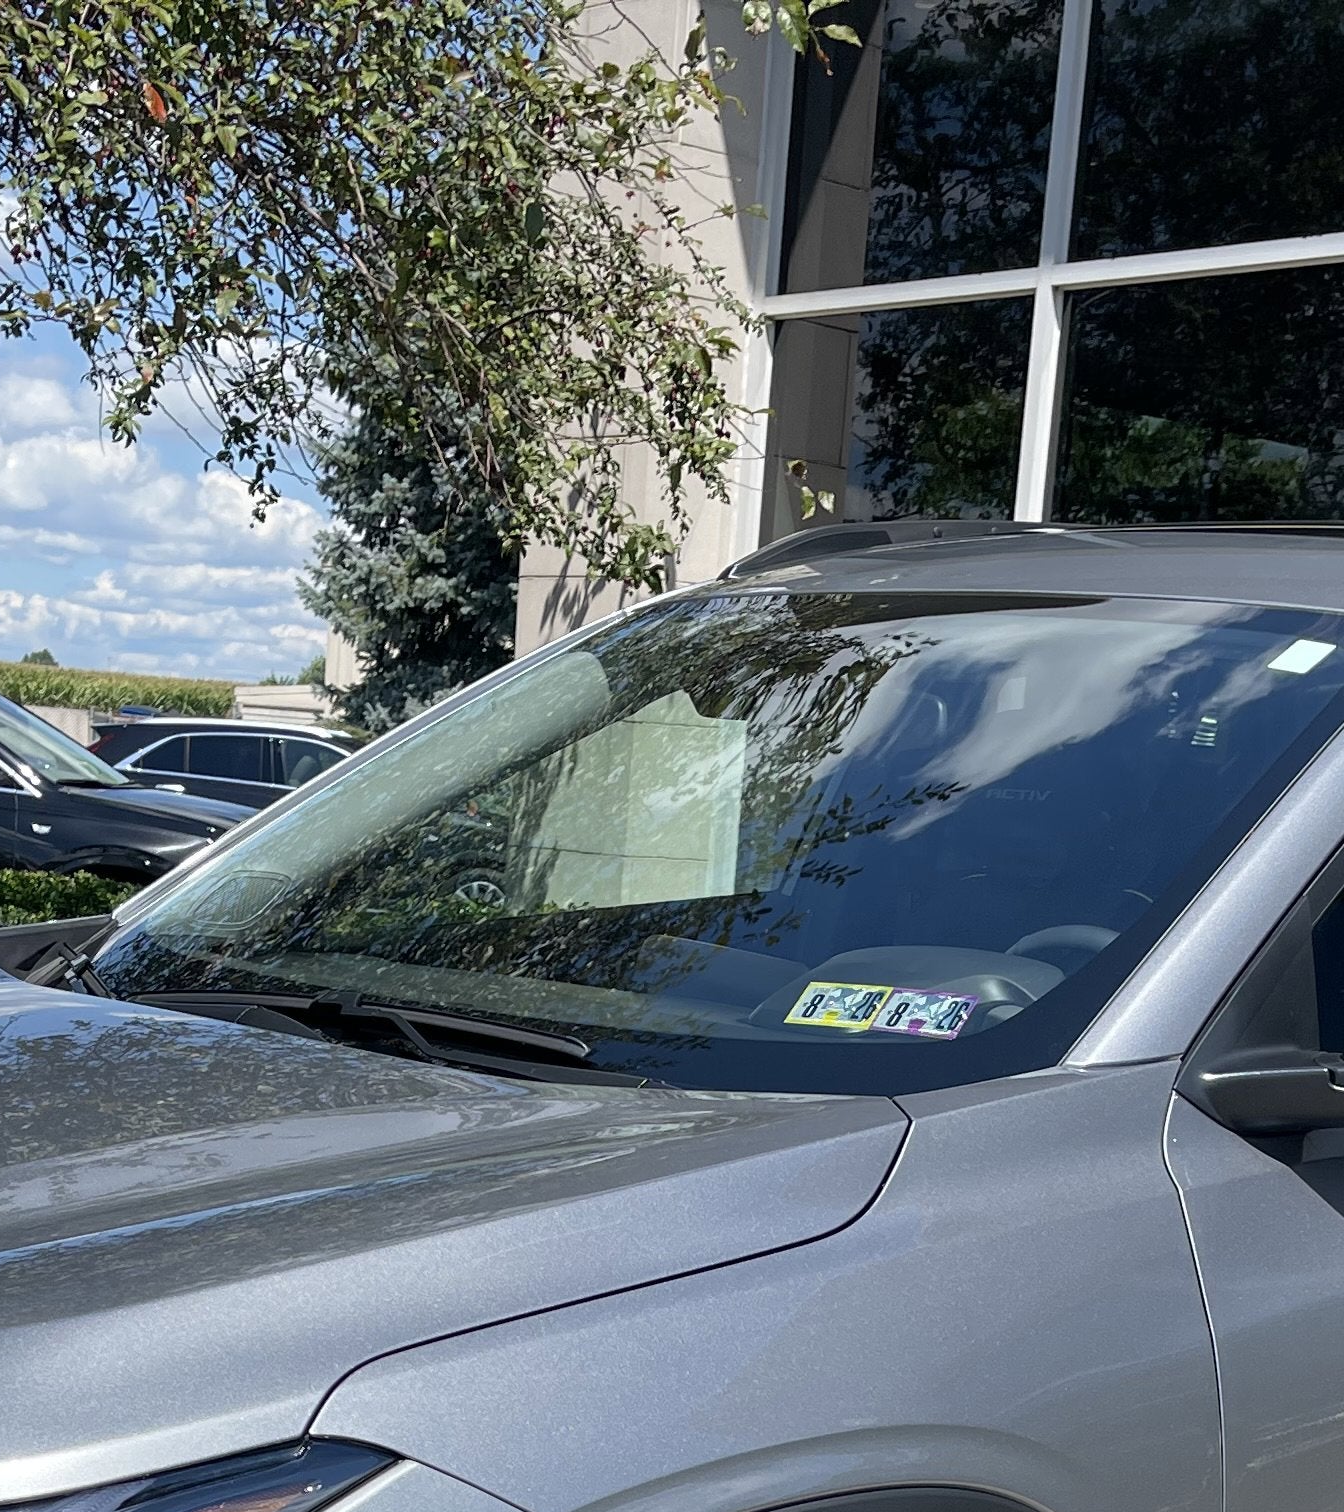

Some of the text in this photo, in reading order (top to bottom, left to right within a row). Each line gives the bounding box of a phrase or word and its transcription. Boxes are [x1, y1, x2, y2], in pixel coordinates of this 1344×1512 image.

[985, 788, 1052, 801] ACTIV
[801, 991, 884, 1021] 8 26
[885, 1000, 970, 1031] 8 26
